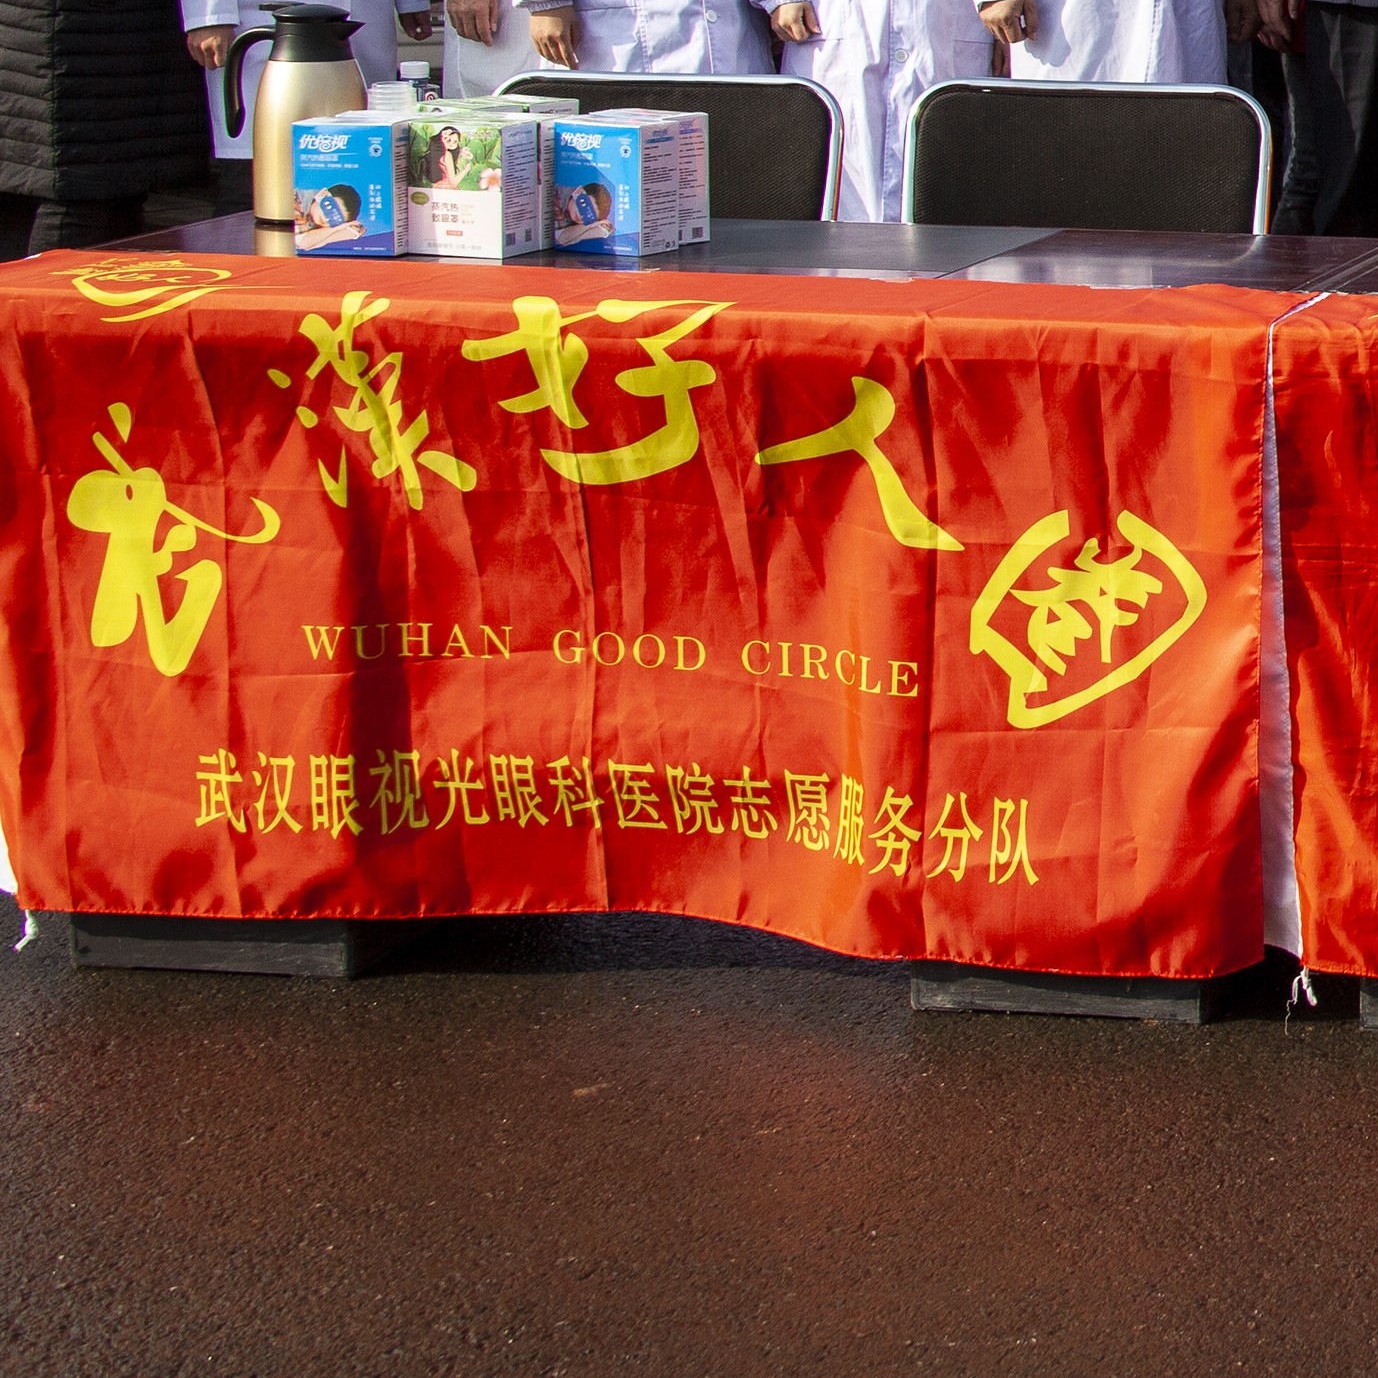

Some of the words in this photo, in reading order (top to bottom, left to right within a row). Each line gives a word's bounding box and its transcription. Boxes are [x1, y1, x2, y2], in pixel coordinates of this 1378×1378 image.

[303, 623, 516, 662] WUHAN
[553, 629, 707, 672] GOOD
[741, 639, 922, 700] CIRCLE
[194, 747, 1040, 888] 武汉眼视光眼科医院志愿服务分队
